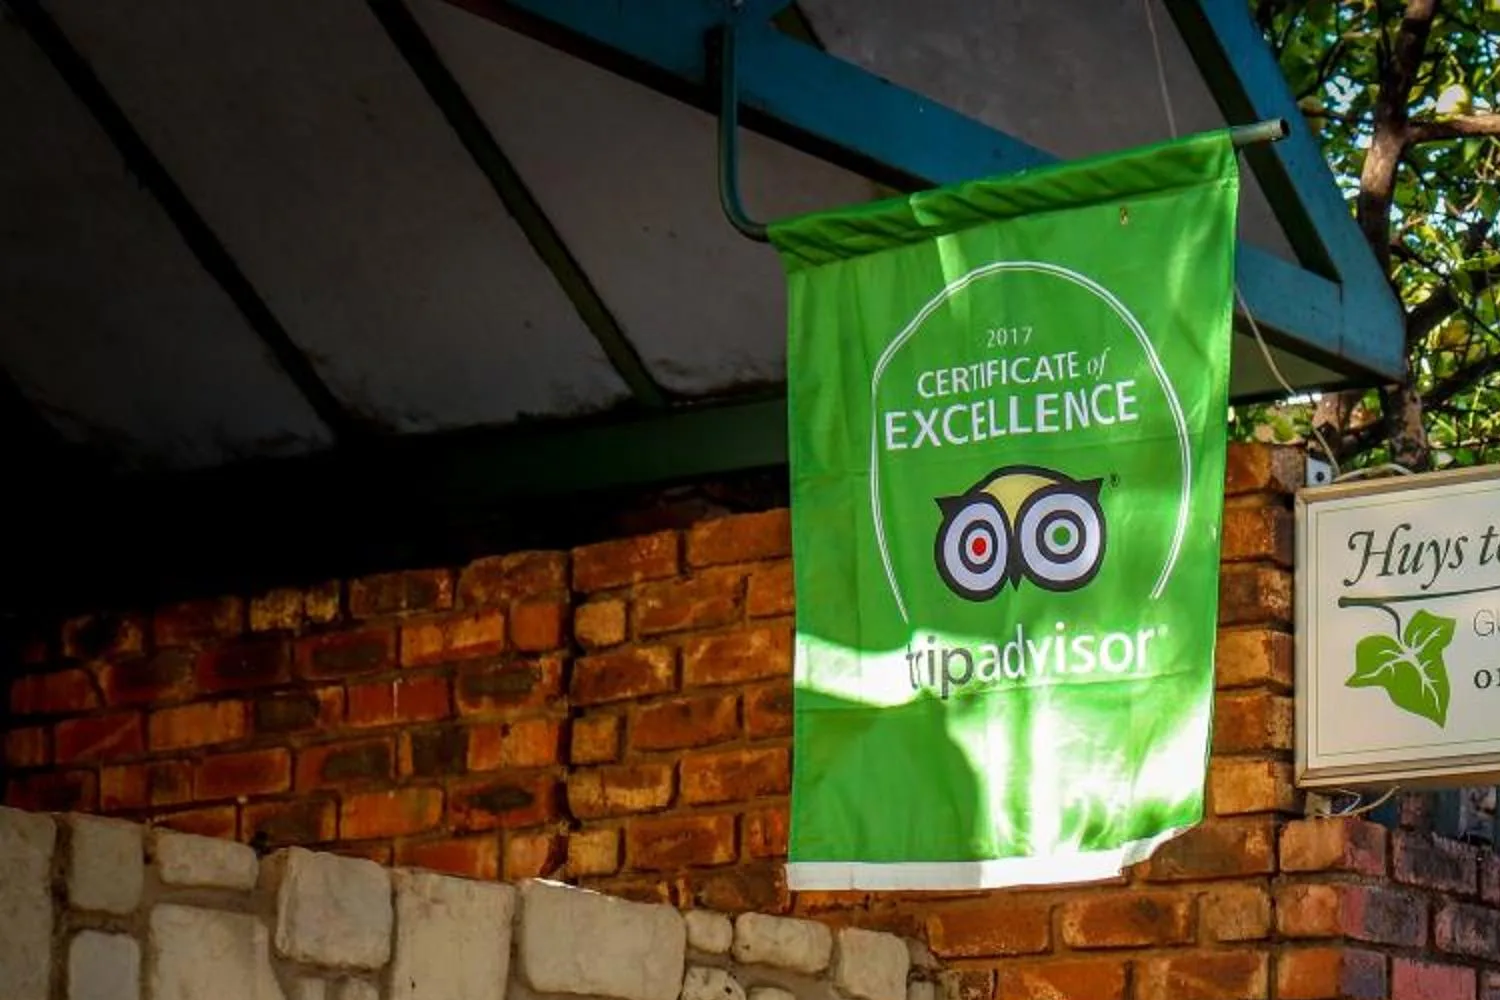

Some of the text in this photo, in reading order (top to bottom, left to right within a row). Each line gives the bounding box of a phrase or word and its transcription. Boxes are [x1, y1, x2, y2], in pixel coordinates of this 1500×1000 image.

[986, 326, 1033, 348] 2017
[917, 347, 1111, 399] CERTIFICATE of
[884, 380, 1139, 451] EXCELLENCE
[1343, 522, 1469, 590] Huys
[905, 621, 1154, 700] tripadvisor
